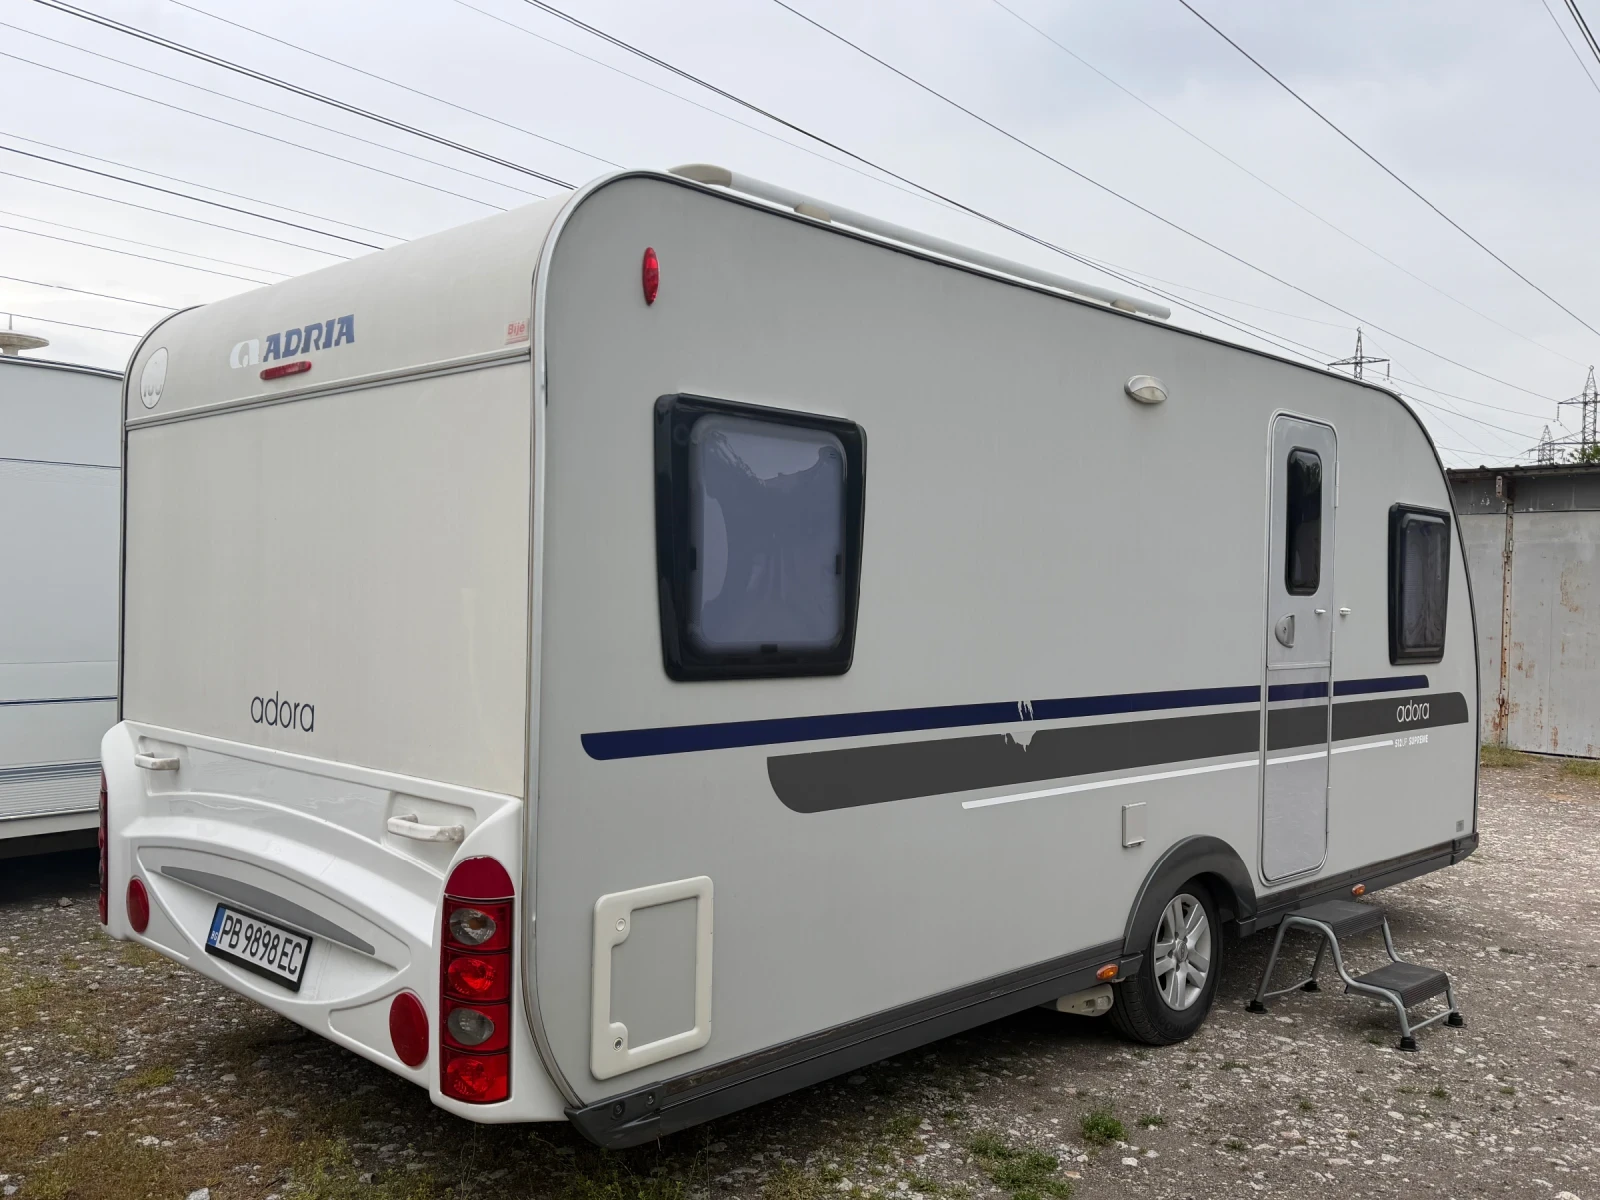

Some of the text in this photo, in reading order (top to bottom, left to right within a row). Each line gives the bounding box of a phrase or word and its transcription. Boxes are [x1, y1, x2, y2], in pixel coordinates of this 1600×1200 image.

[262, 314, 355, 362] ADRIA
[250, 690, 315, 733] adora
[1396, 699, 1430, 723] adora
[1408, 734, 1429, 746] SUPREME
[218, 914, 303, 976] PB 9898 EC
